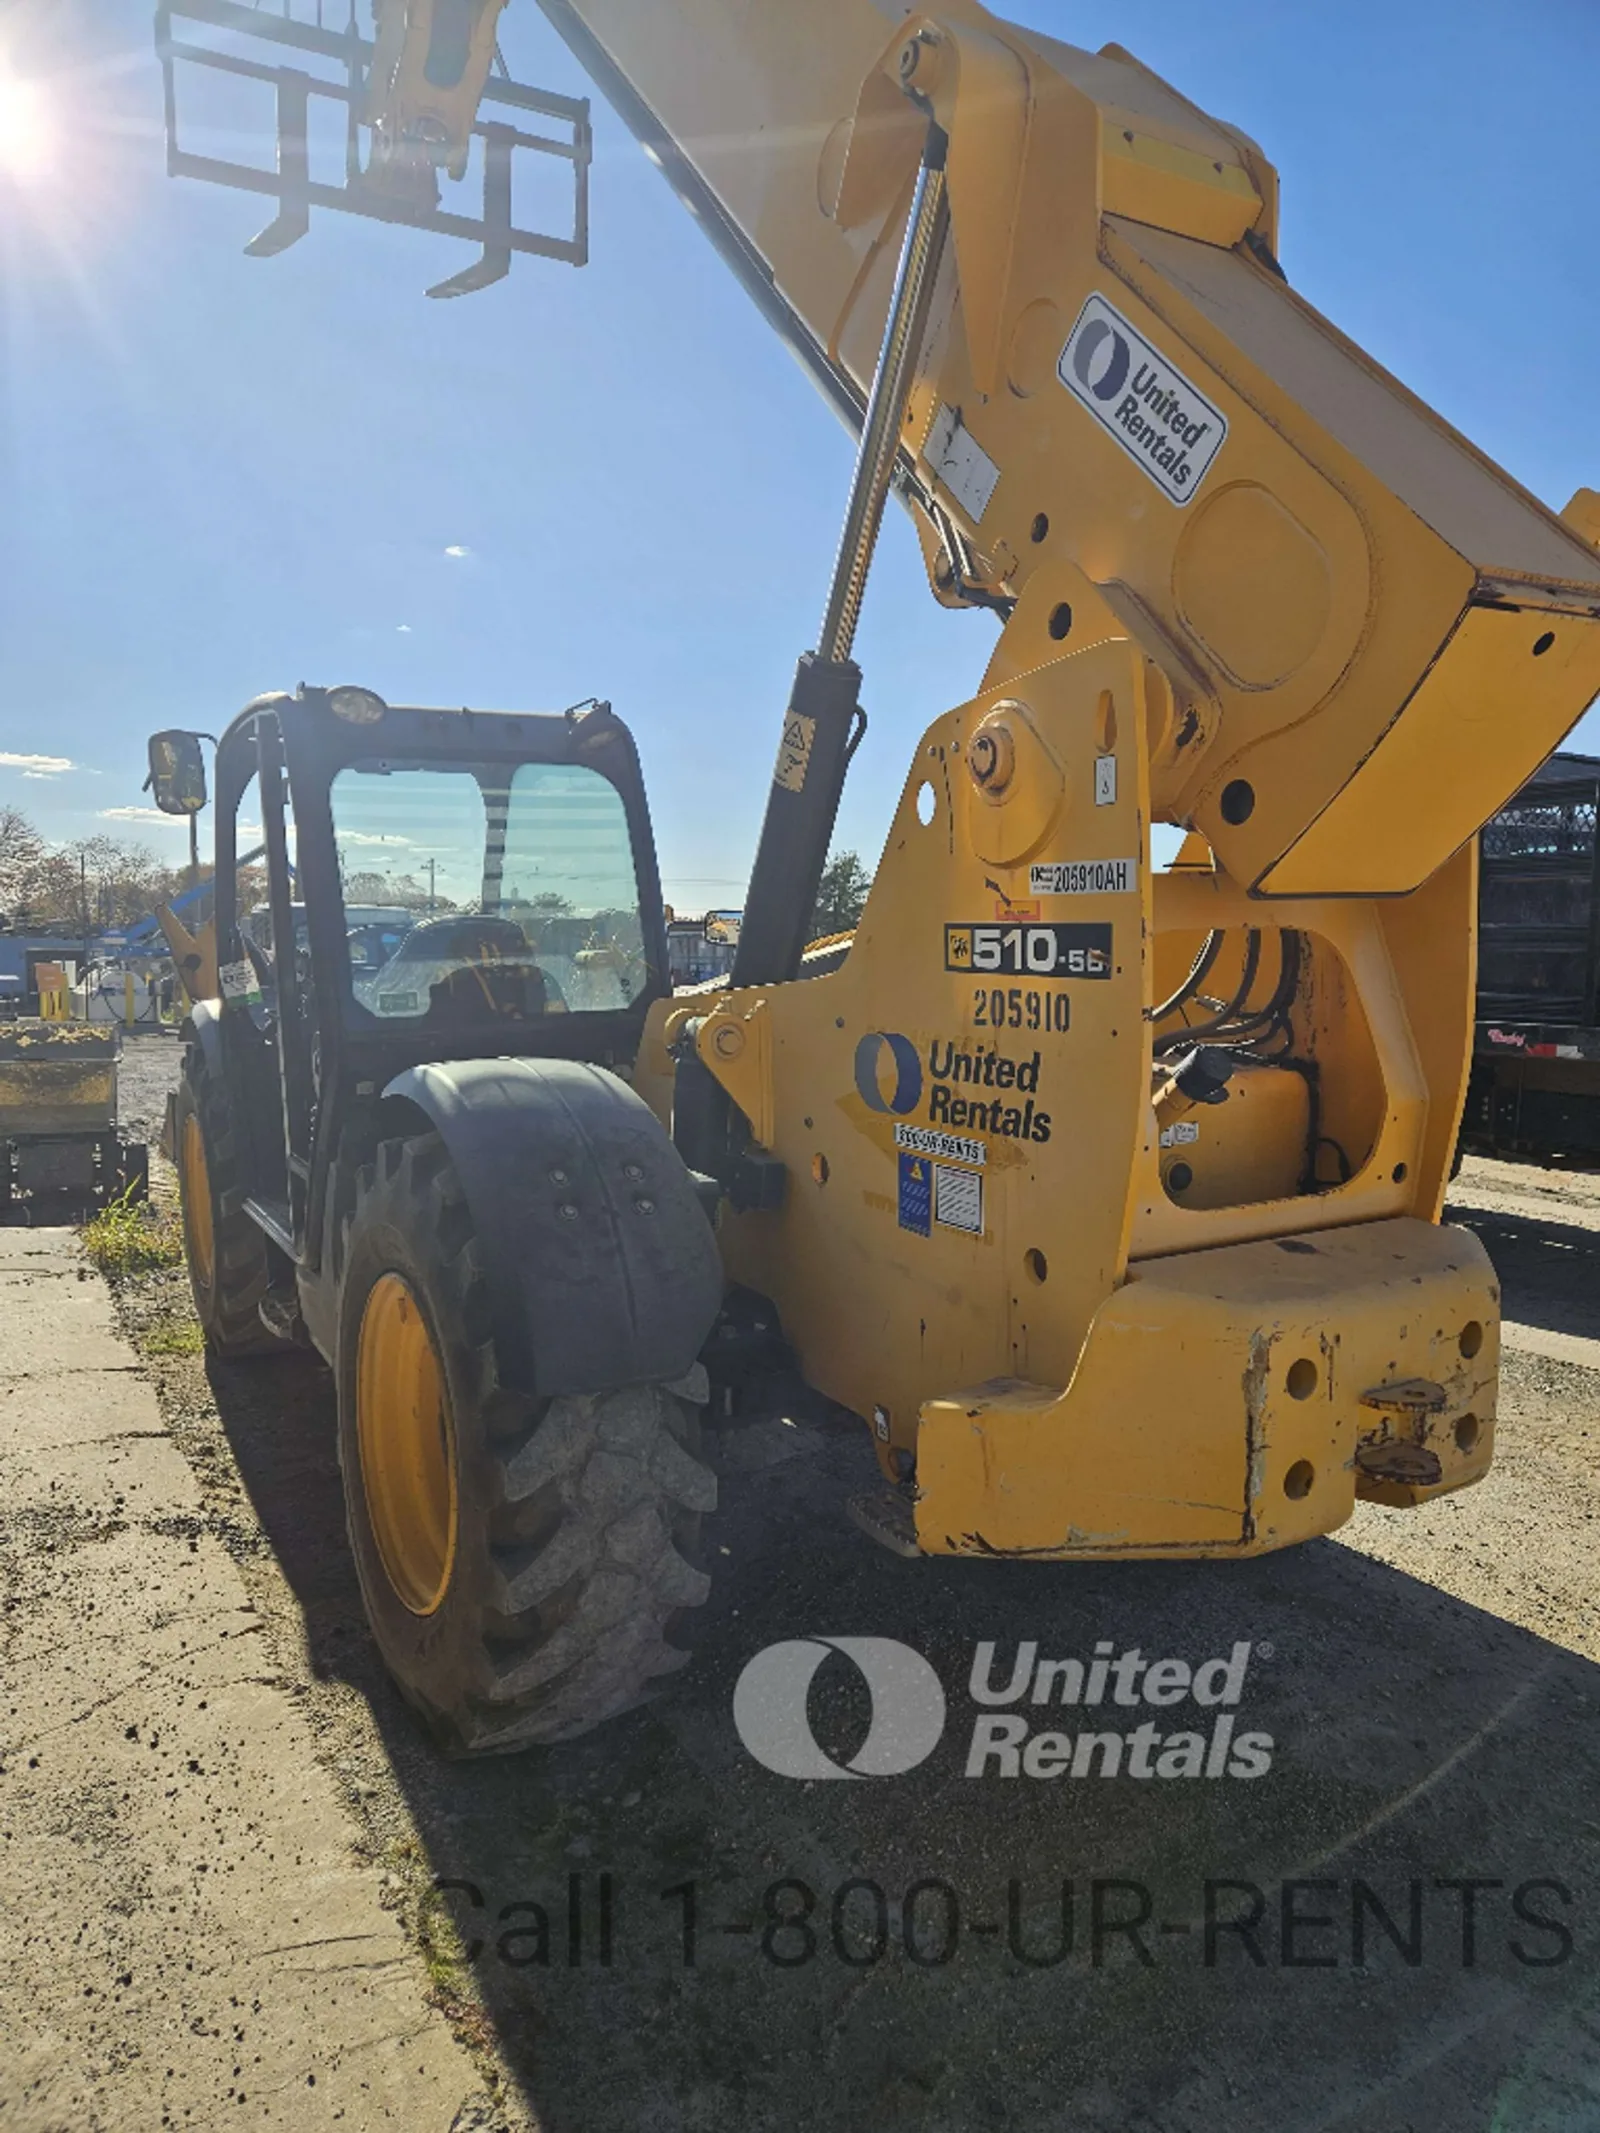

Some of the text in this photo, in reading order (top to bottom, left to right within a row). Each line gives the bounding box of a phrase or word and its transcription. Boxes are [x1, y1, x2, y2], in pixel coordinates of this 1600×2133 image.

[1130, 363, 1207, 449] United
[1114, 394, 1192, 486] Rentals
[1053, 862, 1127, 893] 205910AH
[973, 988, 1071, 1033] 205910
[928, 1040, 1041, 1094] United
[928, 1084, 1051, 1143] Rentals
